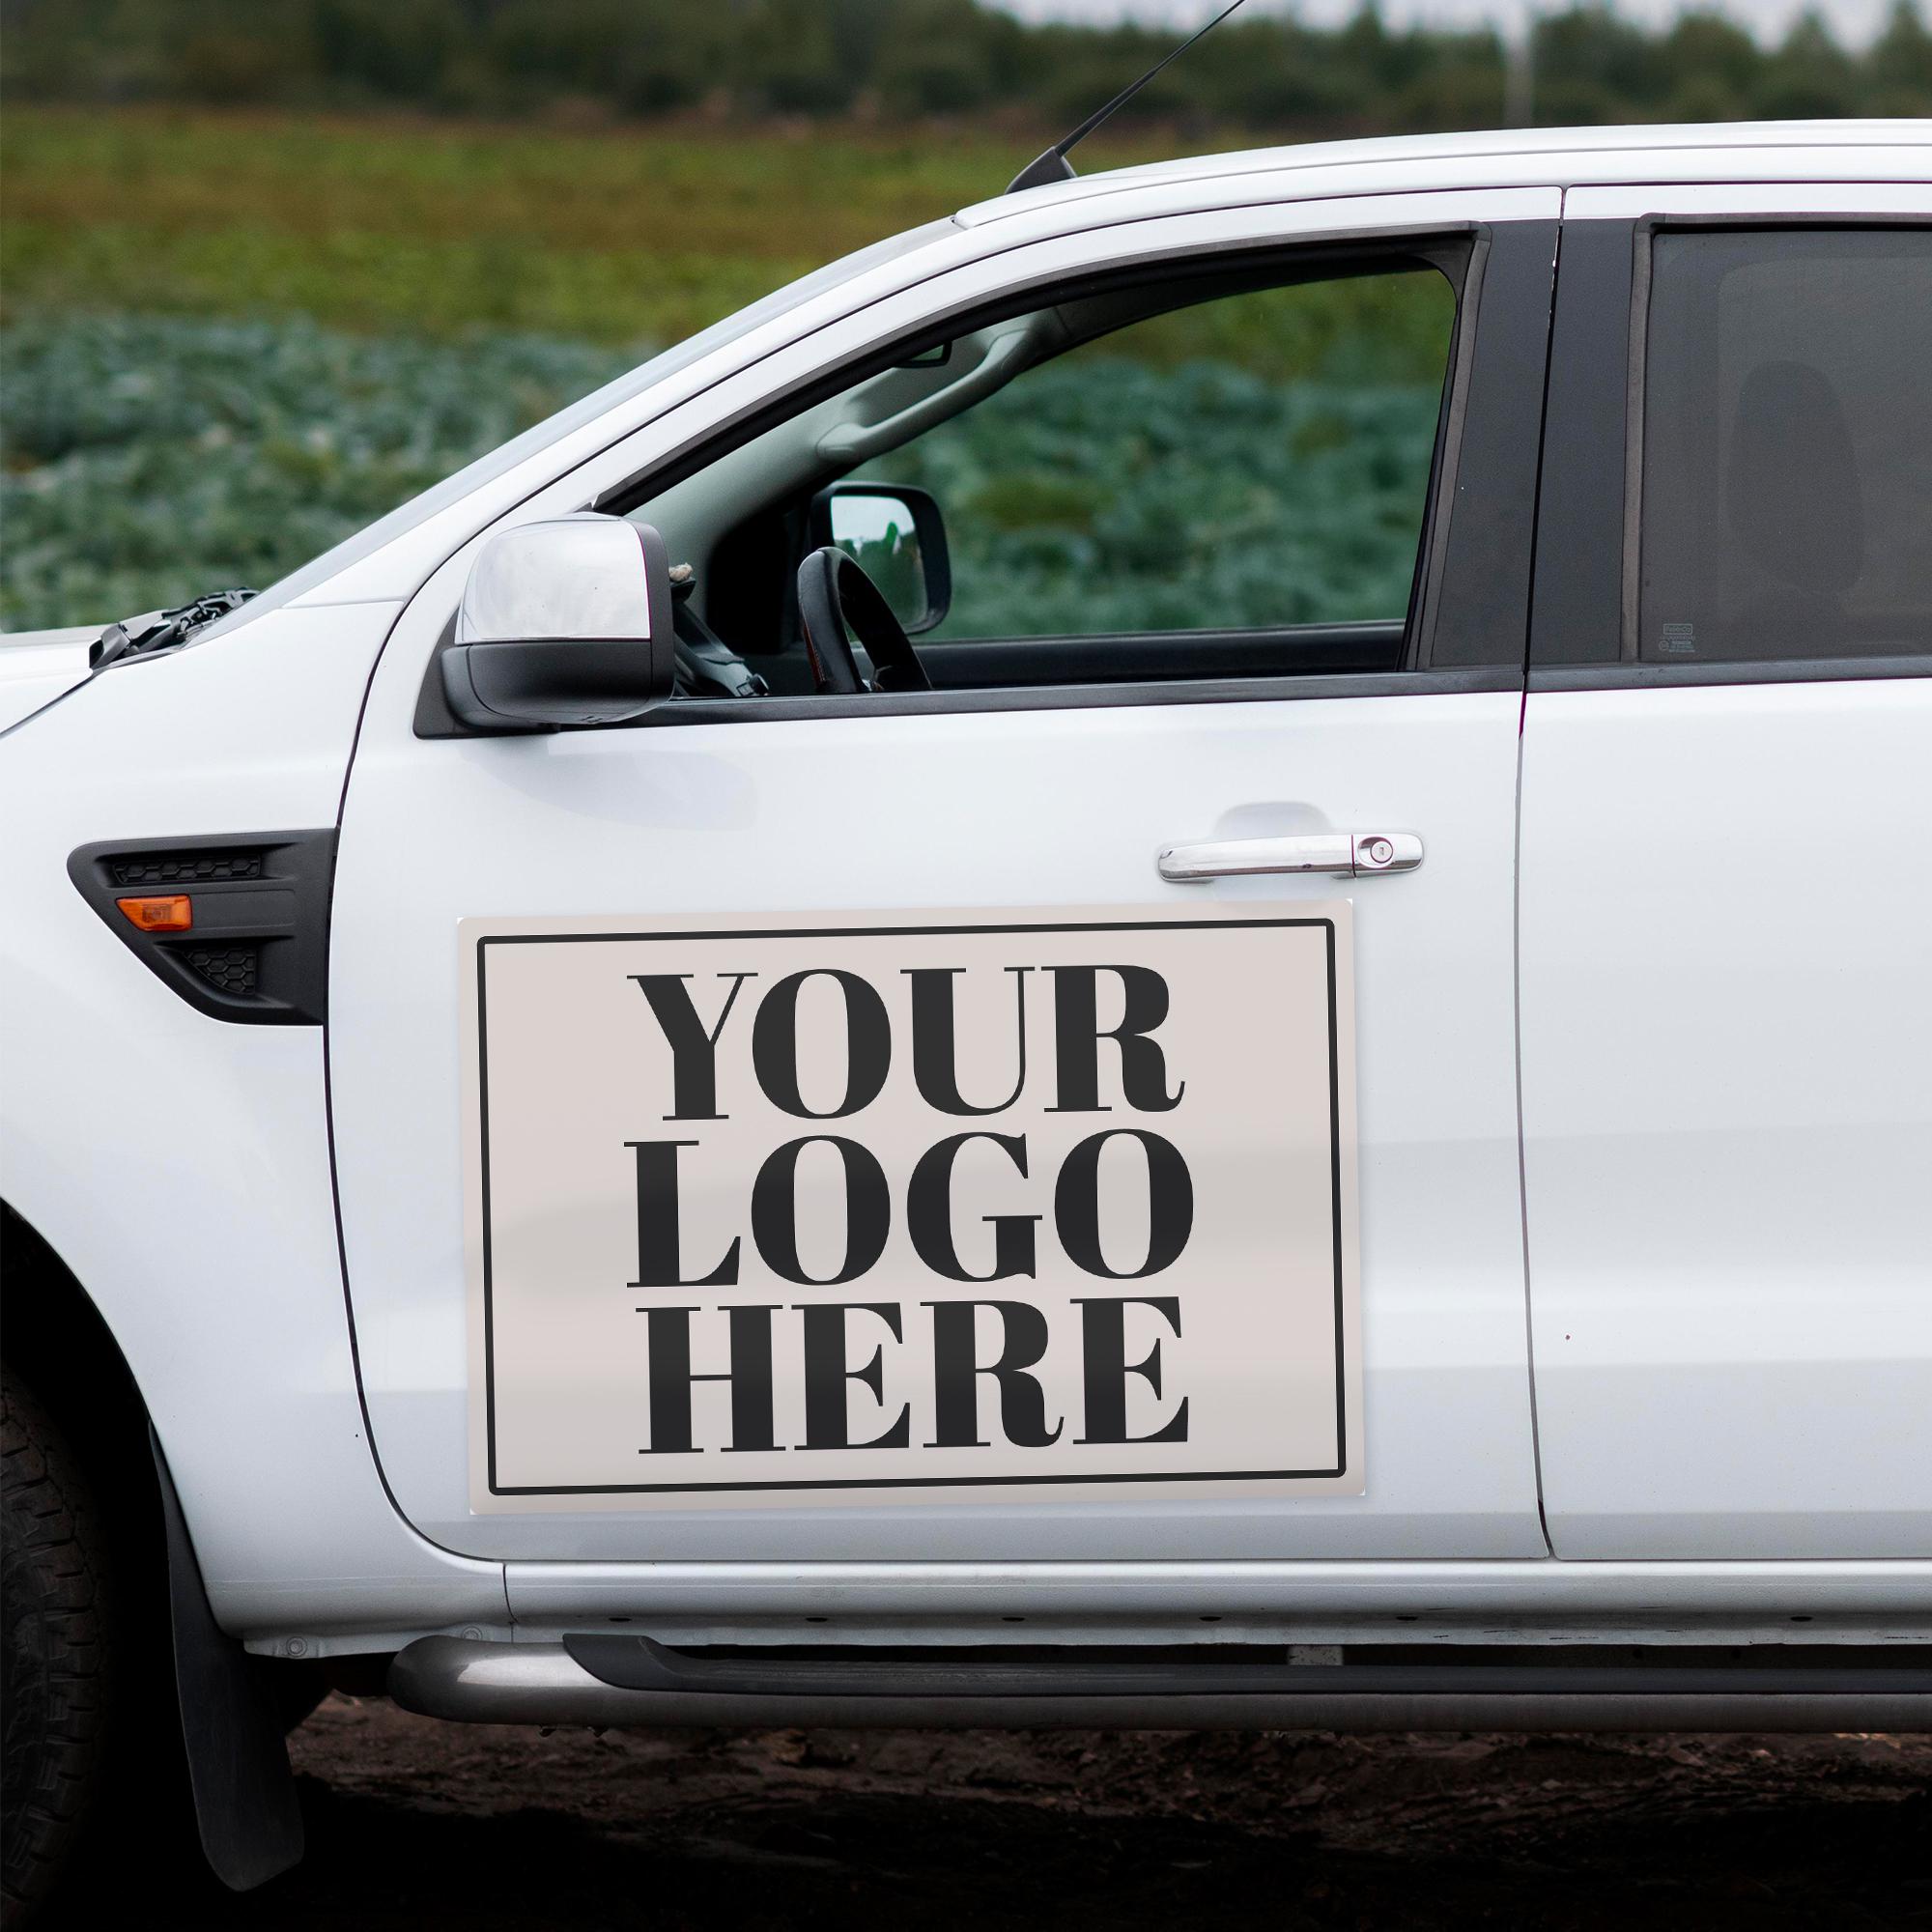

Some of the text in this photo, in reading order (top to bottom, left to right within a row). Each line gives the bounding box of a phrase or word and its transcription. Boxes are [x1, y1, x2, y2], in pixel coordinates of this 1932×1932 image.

[627, 965, 1185, 1121] YOUR
[624, 1129, 1193, 1288] LOGO
[636, 1296, 1188, 1454] HERE
